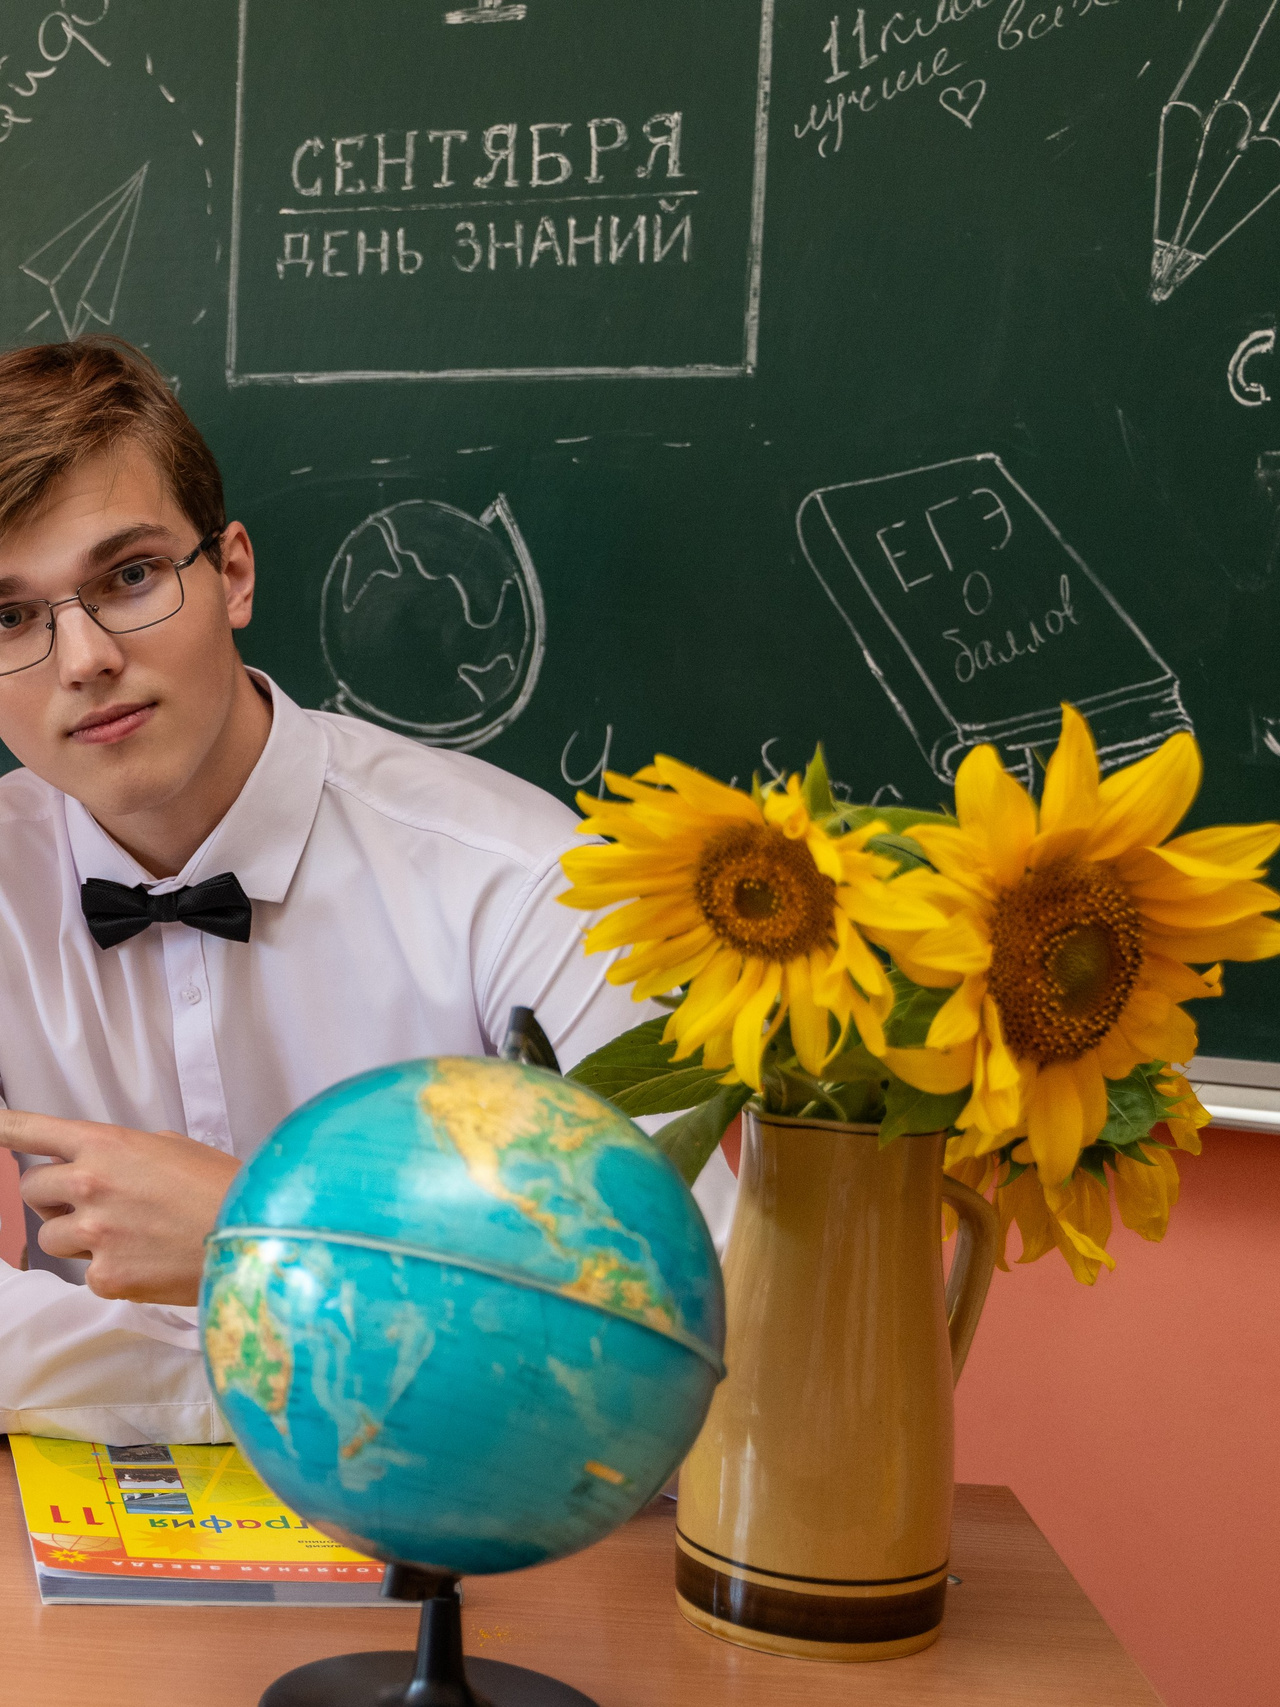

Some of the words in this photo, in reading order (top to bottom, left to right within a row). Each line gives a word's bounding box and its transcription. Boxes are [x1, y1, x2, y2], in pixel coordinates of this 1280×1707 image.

[290, 111, 684, 197] СЕНТЯБРЯ
[276, 226, 423, 280] ДЕНЬ
[452, 198, 693, 273] ЗНАНИЙ
[877, 488, 1012, 593] ЕГЭ
[943, 574, 1082, 683] баллов
[48, 1505, 104, 1527] 11
[148, 1514, 312, 1534] графия
[111, 1560, 221, 1572] ЗВЕЗДА
